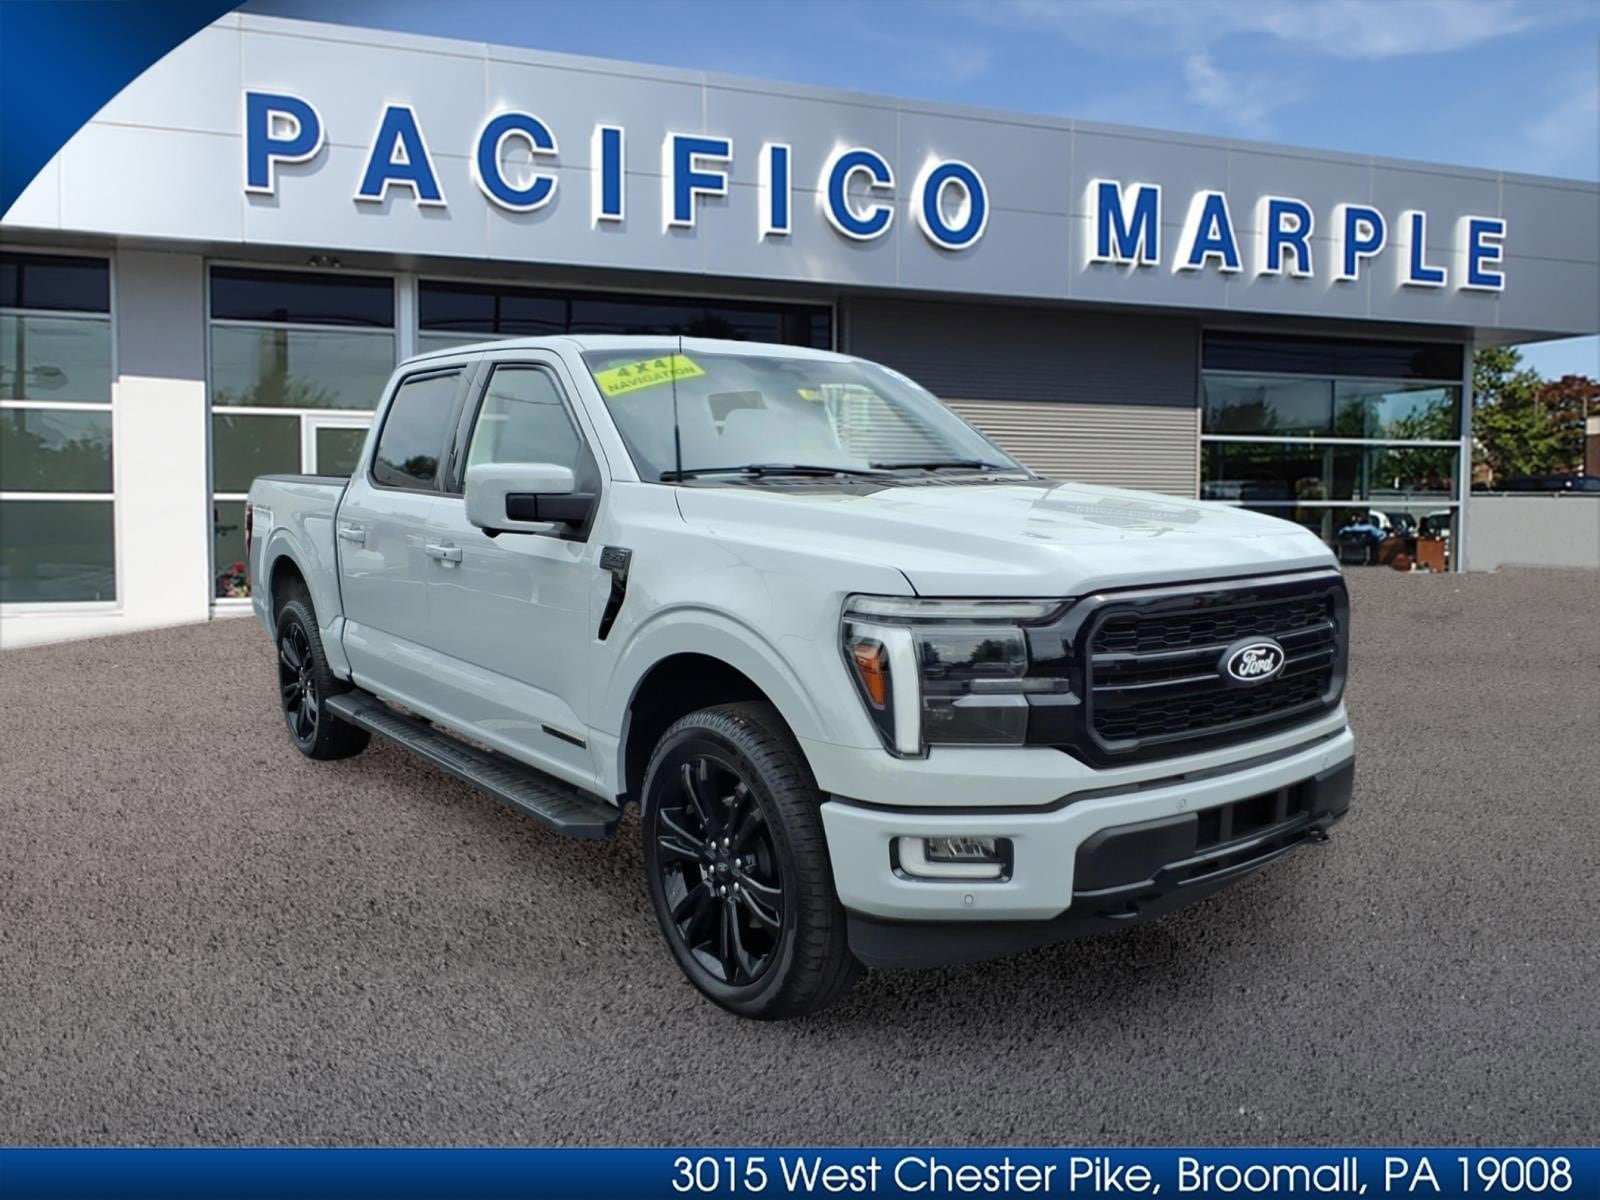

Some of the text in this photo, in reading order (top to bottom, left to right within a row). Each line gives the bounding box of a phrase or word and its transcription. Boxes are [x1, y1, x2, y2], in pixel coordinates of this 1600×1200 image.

[244, 88, 1507, 291] PACIFICO MARPLE
[1239, 648, 1274, 676] Ford
